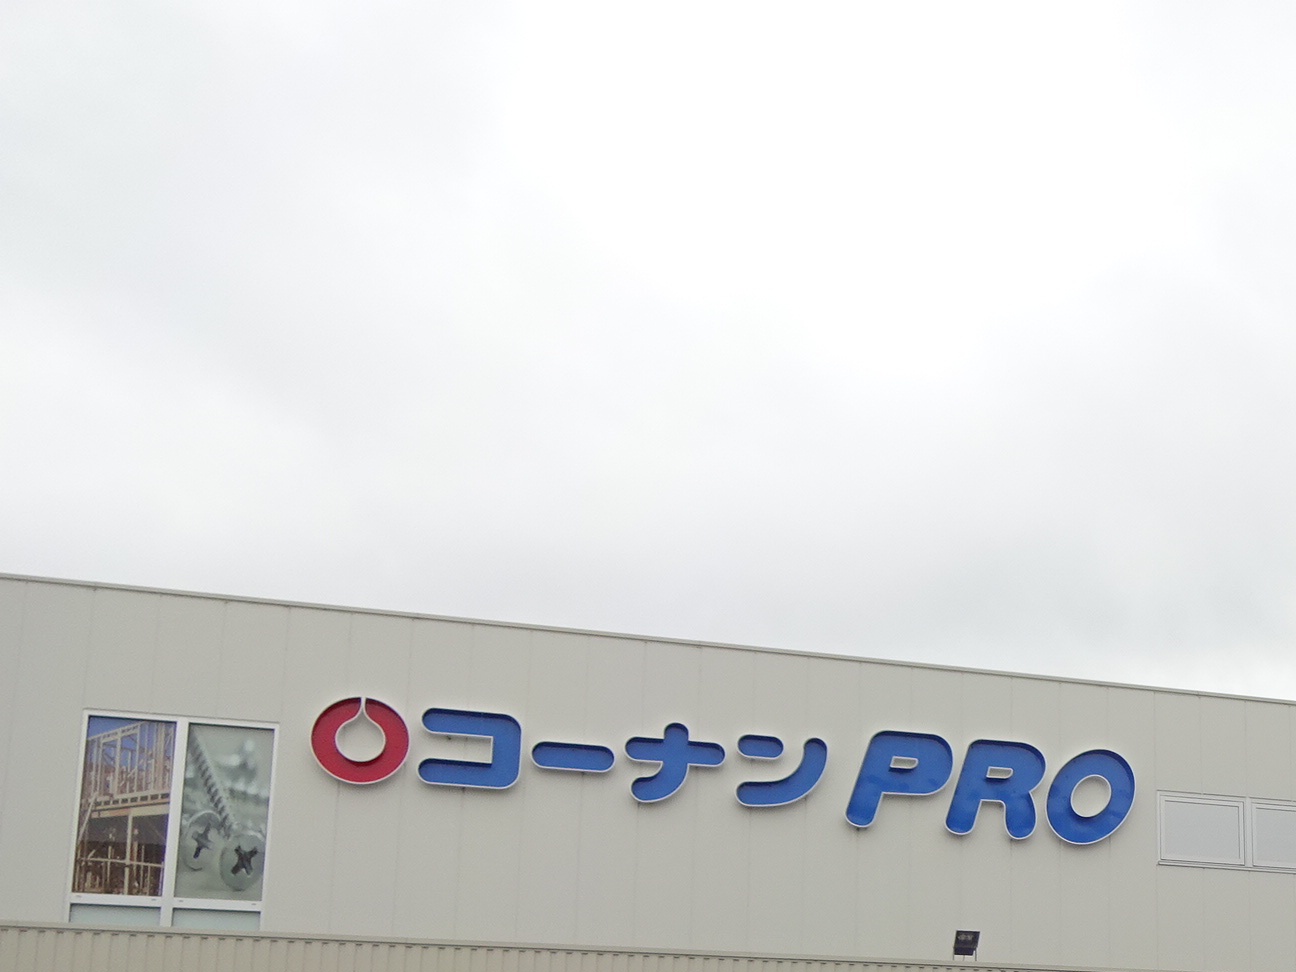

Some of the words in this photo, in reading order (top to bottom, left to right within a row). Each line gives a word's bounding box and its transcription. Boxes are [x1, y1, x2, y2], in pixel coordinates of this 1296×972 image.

[417, 708, 827, 808] コーナン
[845, 729, 1137, 847] PRO
